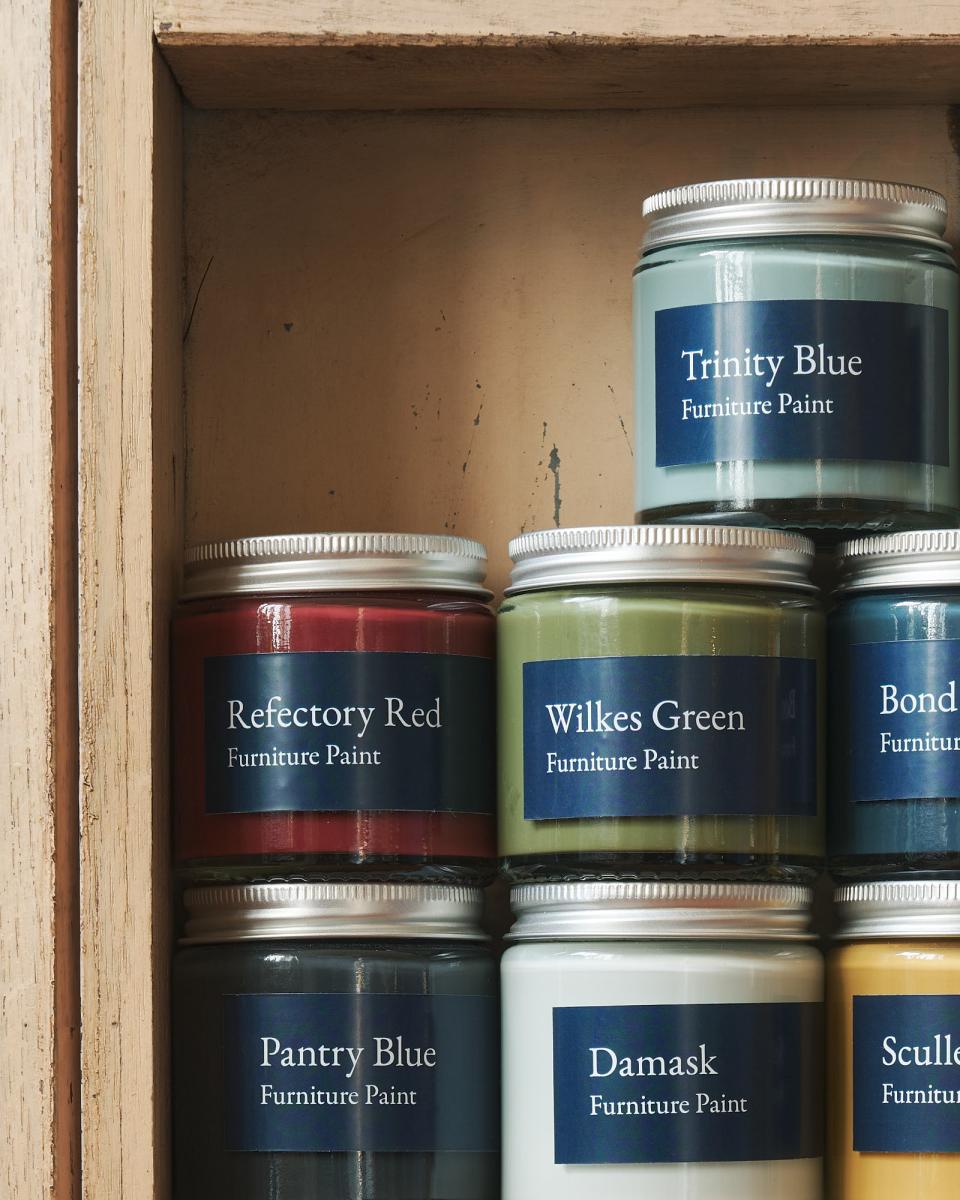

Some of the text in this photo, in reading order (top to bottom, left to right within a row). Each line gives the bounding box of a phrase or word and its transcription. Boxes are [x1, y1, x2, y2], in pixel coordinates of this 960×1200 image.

[681, 344, 862, 387] Trinity Blue
[682, 393, 833, 420] Furniture Paint
[880, 681, 958, 714] Bond
[228, 696, 441, 737] Refectory Red
[545, 701, 642, 734] Wilkes
[653, 700, 745, 730] Green
[229, 745, 381, 767] Furniture Paint
[547, 749, 699, 773] Furniture Paint
[261, 1036, 435, 1078] Pantry Blue
[589, 1044, 718, 1077] Damask
[261, 1085, 416, 1104] Furniture Paint
[590, 1093, 747, 1115] Furniture Paint
